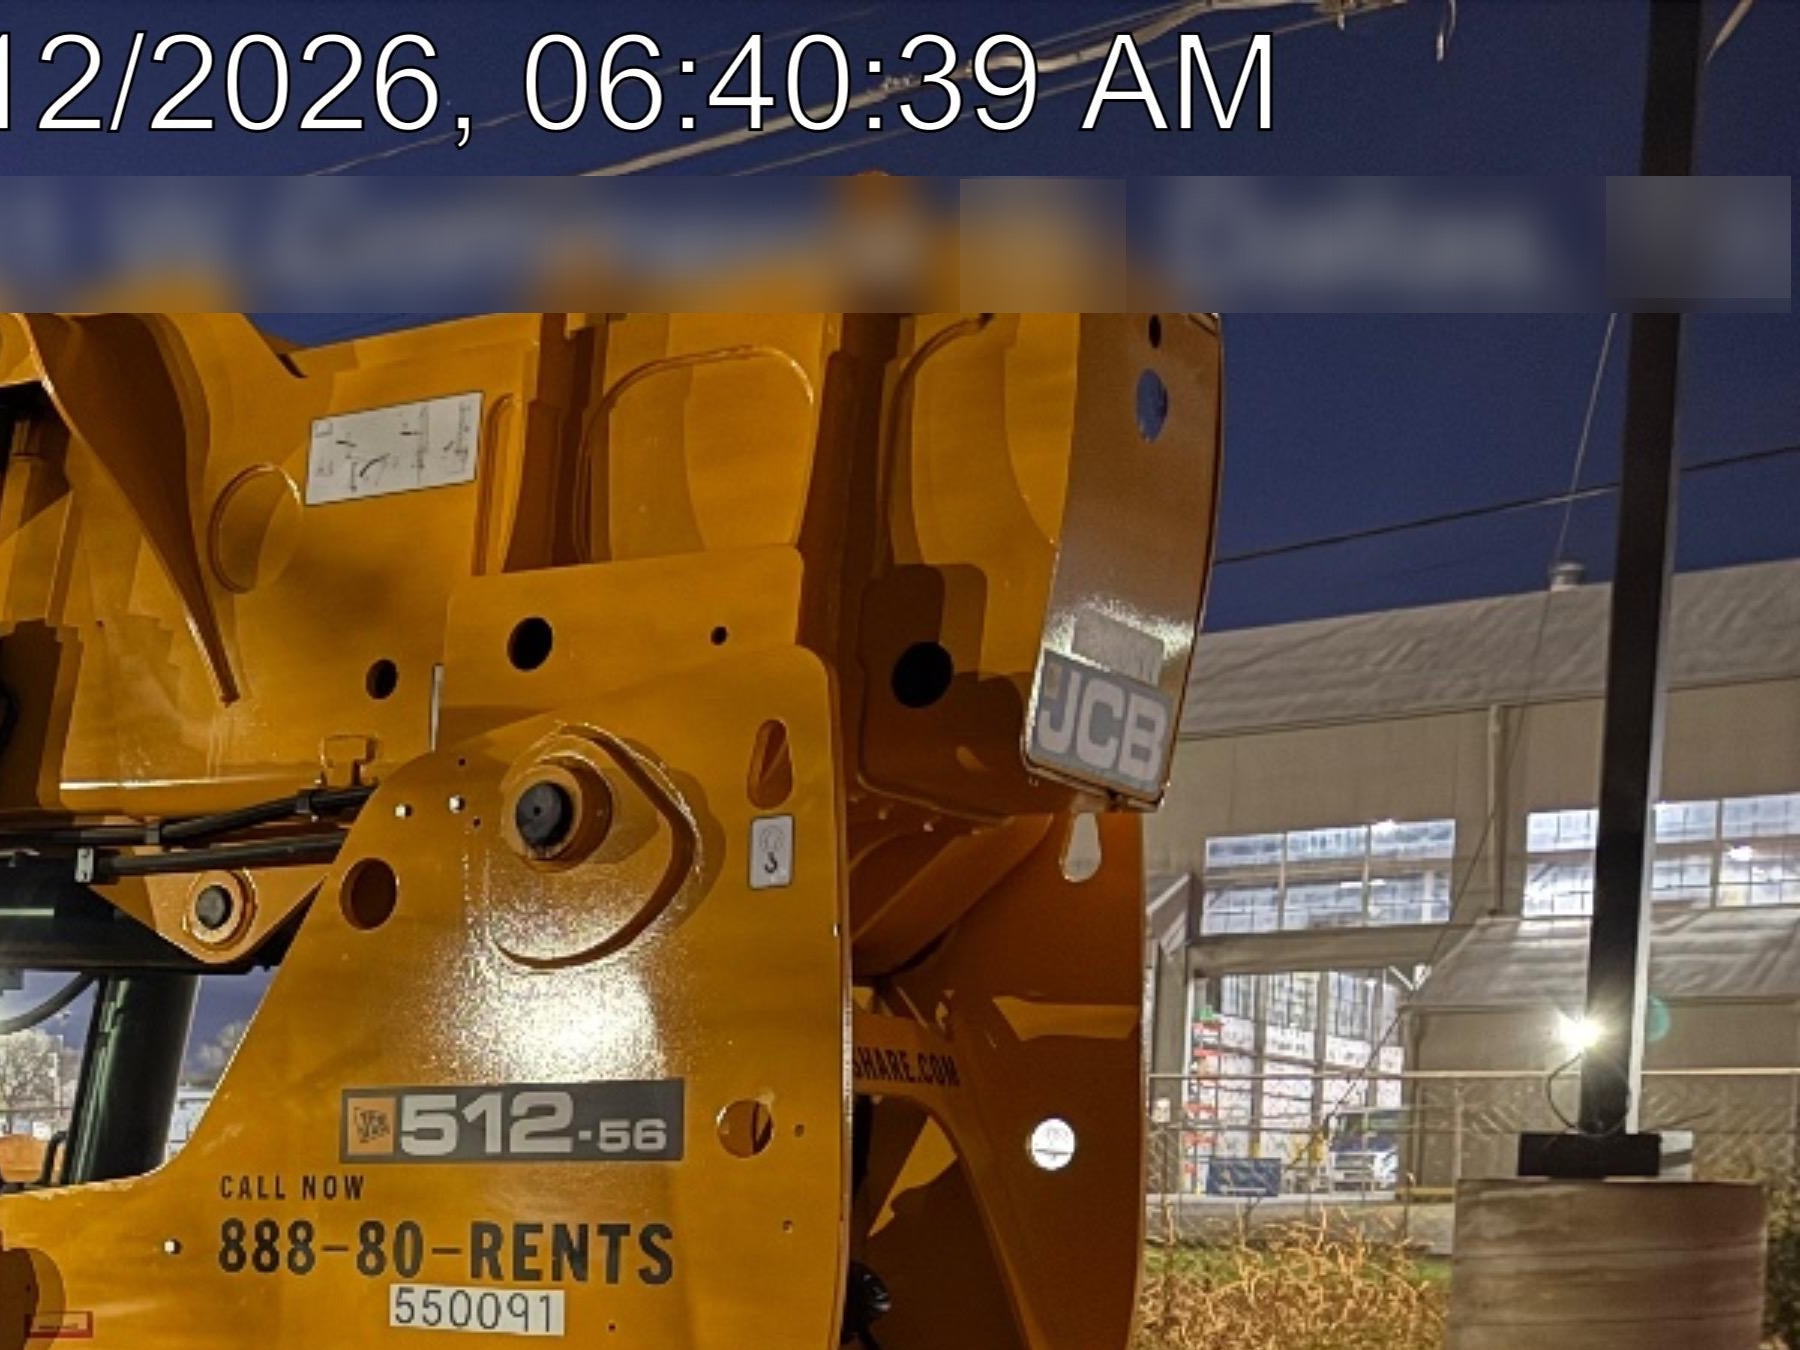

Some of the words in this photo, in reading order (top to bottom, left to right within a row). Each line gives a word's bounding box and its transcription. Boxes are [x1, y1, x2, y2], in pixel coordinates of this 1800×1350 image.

[1037, 669, 1168, 781] JCB
[400, 1091, 668, 1156] 512-56
[221, 1174, 286, 1200] CALL
[302, 1174, 365, 1201] NOW
[218, 1218, 674, 1285] 888-80-RENTS
[394, 1286, 551, 1333] 550091
